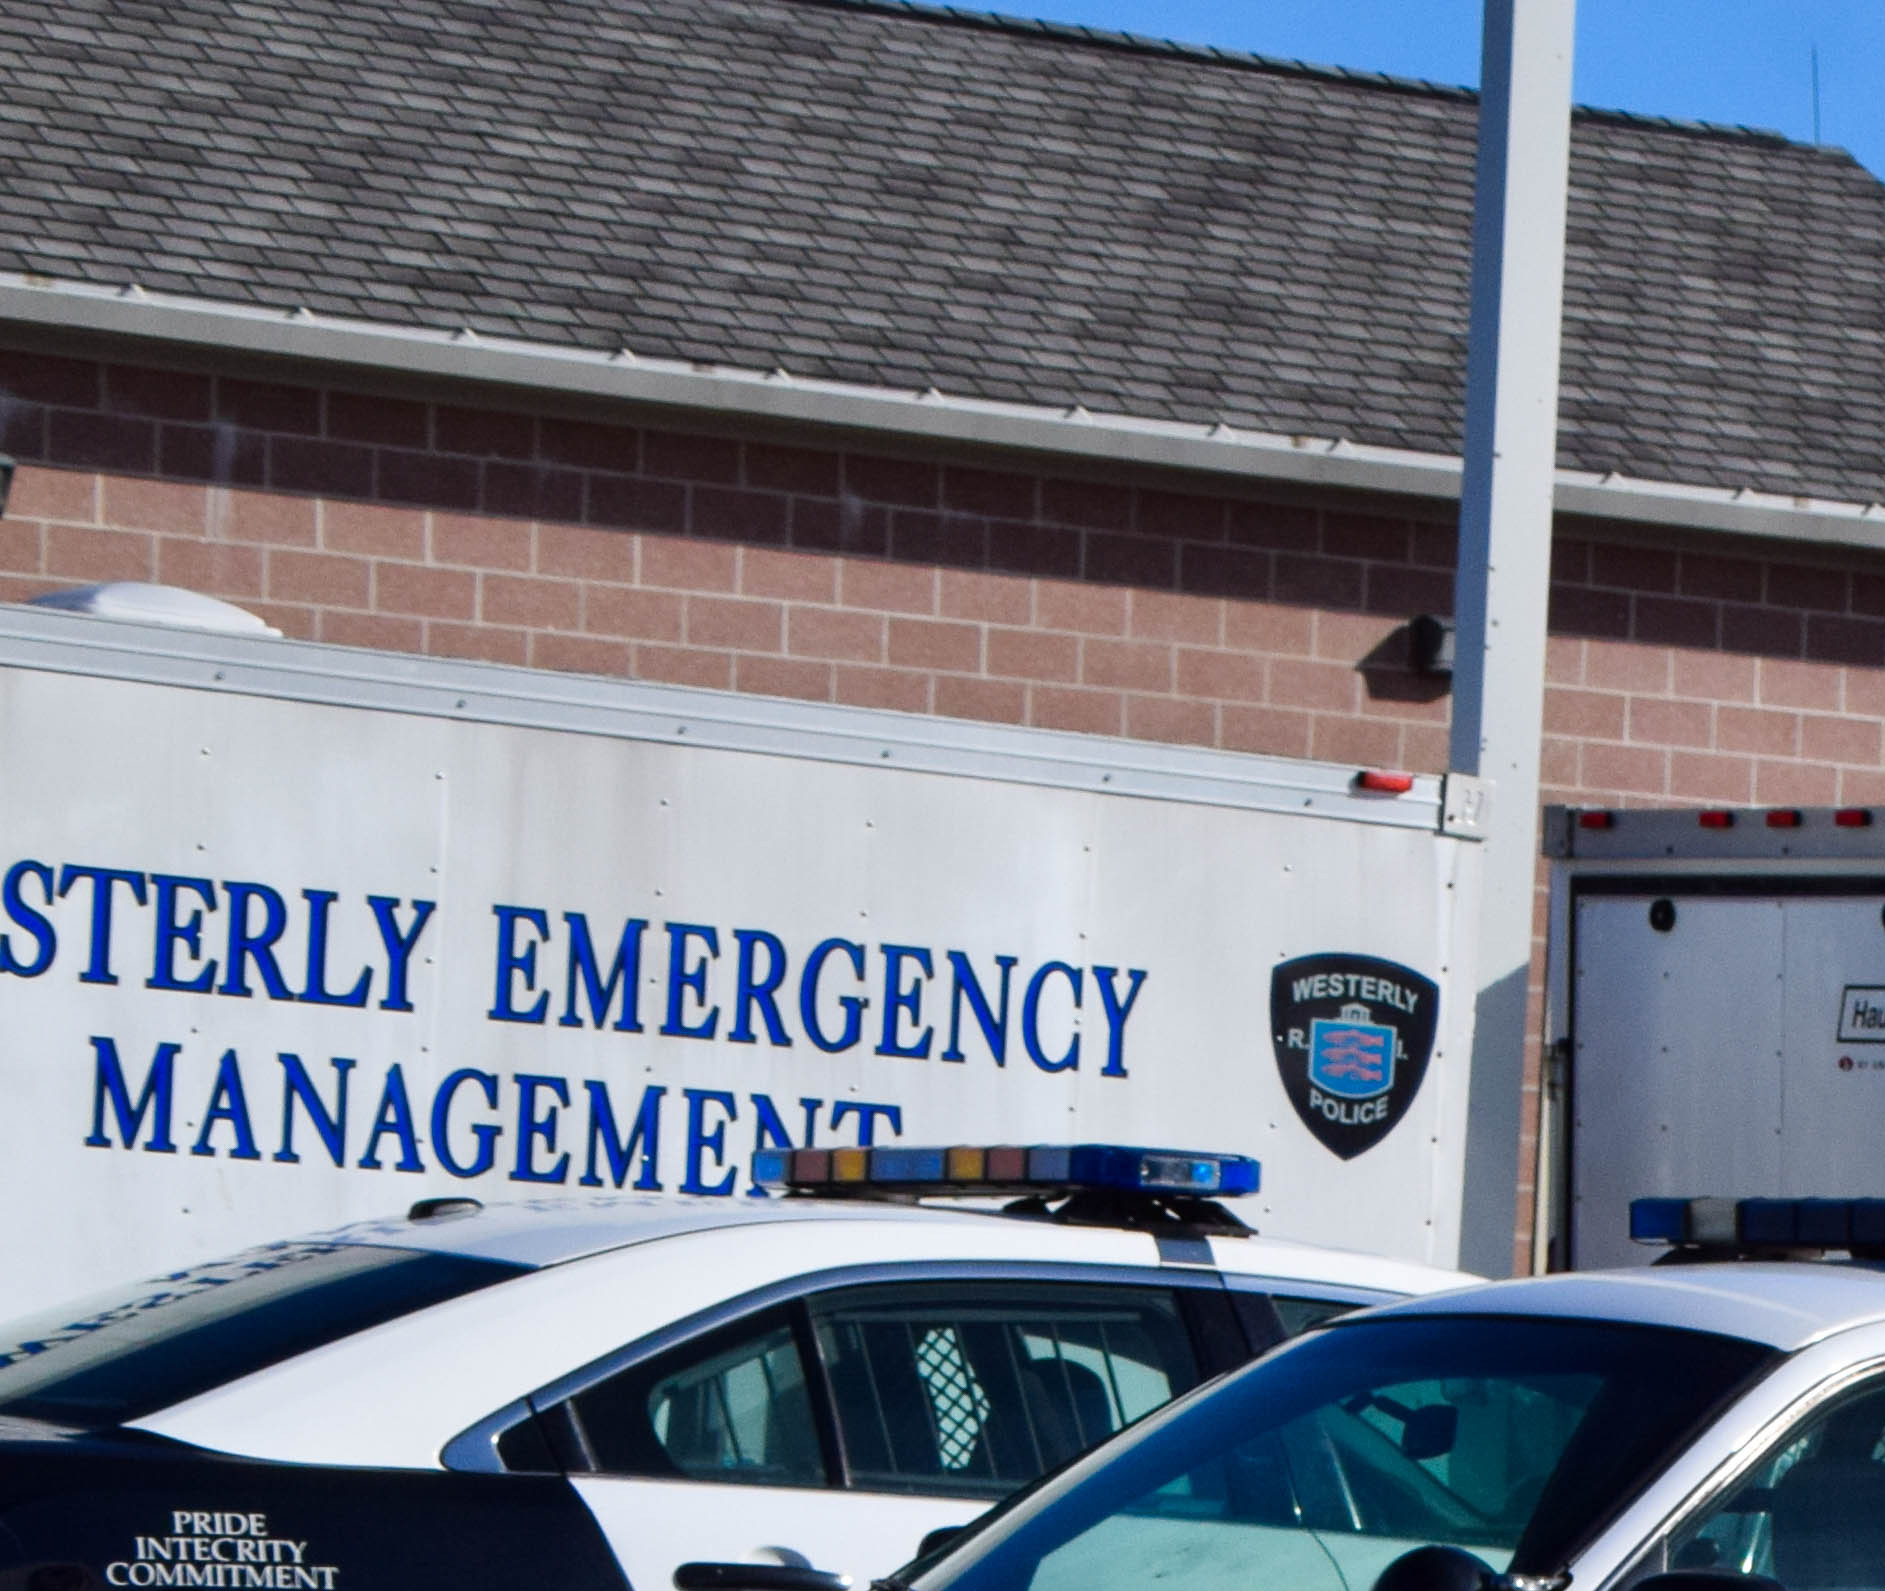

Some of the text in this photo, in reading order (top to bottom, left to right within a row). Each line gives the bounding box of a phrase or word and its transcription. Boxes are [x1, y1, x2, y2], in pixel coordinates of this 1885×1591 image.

[487, 903, 1149, 1079] EMERGENCY
[1292, 973, 1419, 1014] WESTERLY
[1287, 1028, 1310, 1050] R.
[1309, 1087, 1389, 1124] POLICE
[171, 1510, 268, 1537] PRIDE
[105, 1561, 340, 1591] COMMITMENT
